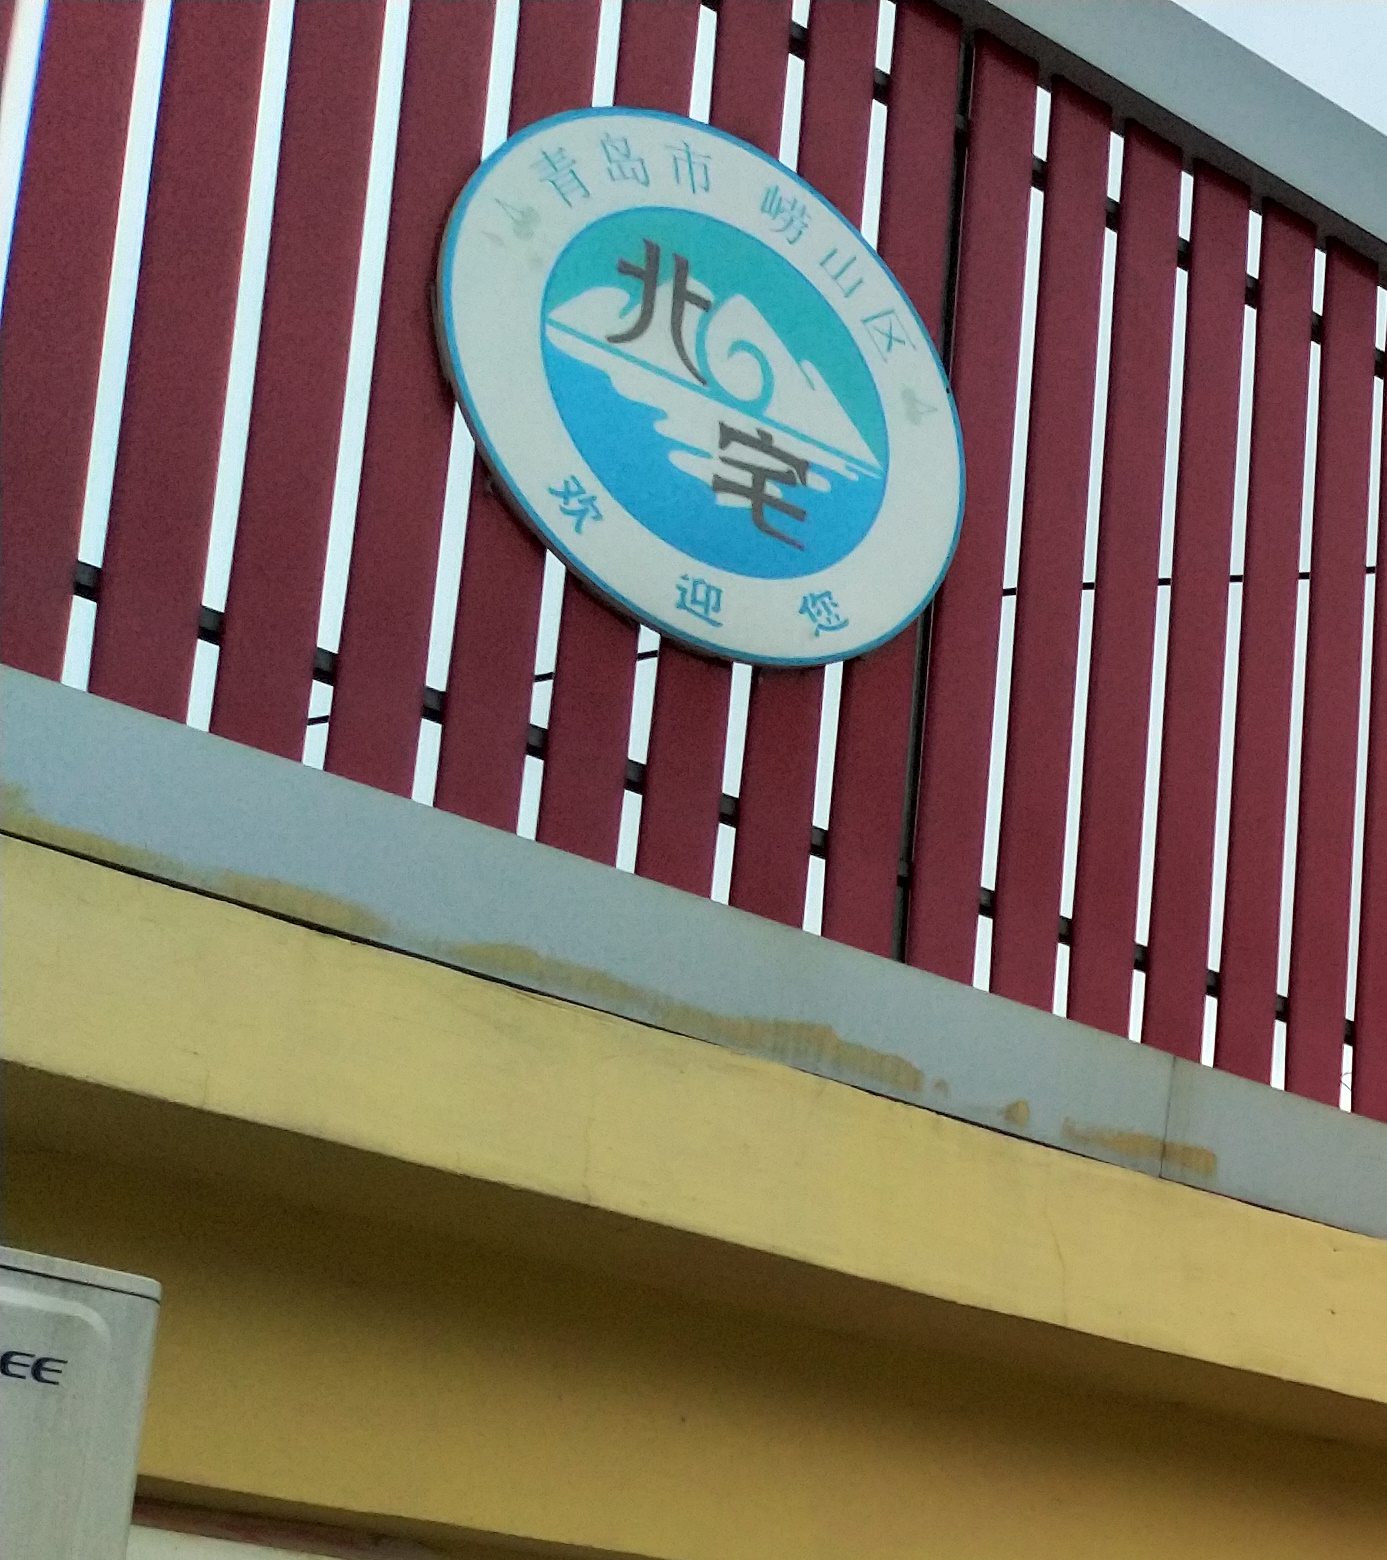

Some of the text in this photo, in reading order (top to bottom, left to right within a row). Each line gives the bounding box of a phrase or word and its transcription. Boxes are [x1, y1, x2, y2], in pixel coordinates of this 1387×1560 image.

[531, 131, 916, 361] 青岛市崂山区
[607, 237, 809, 551] 北宅
[549, 475, 849, 635] 欢迎您
